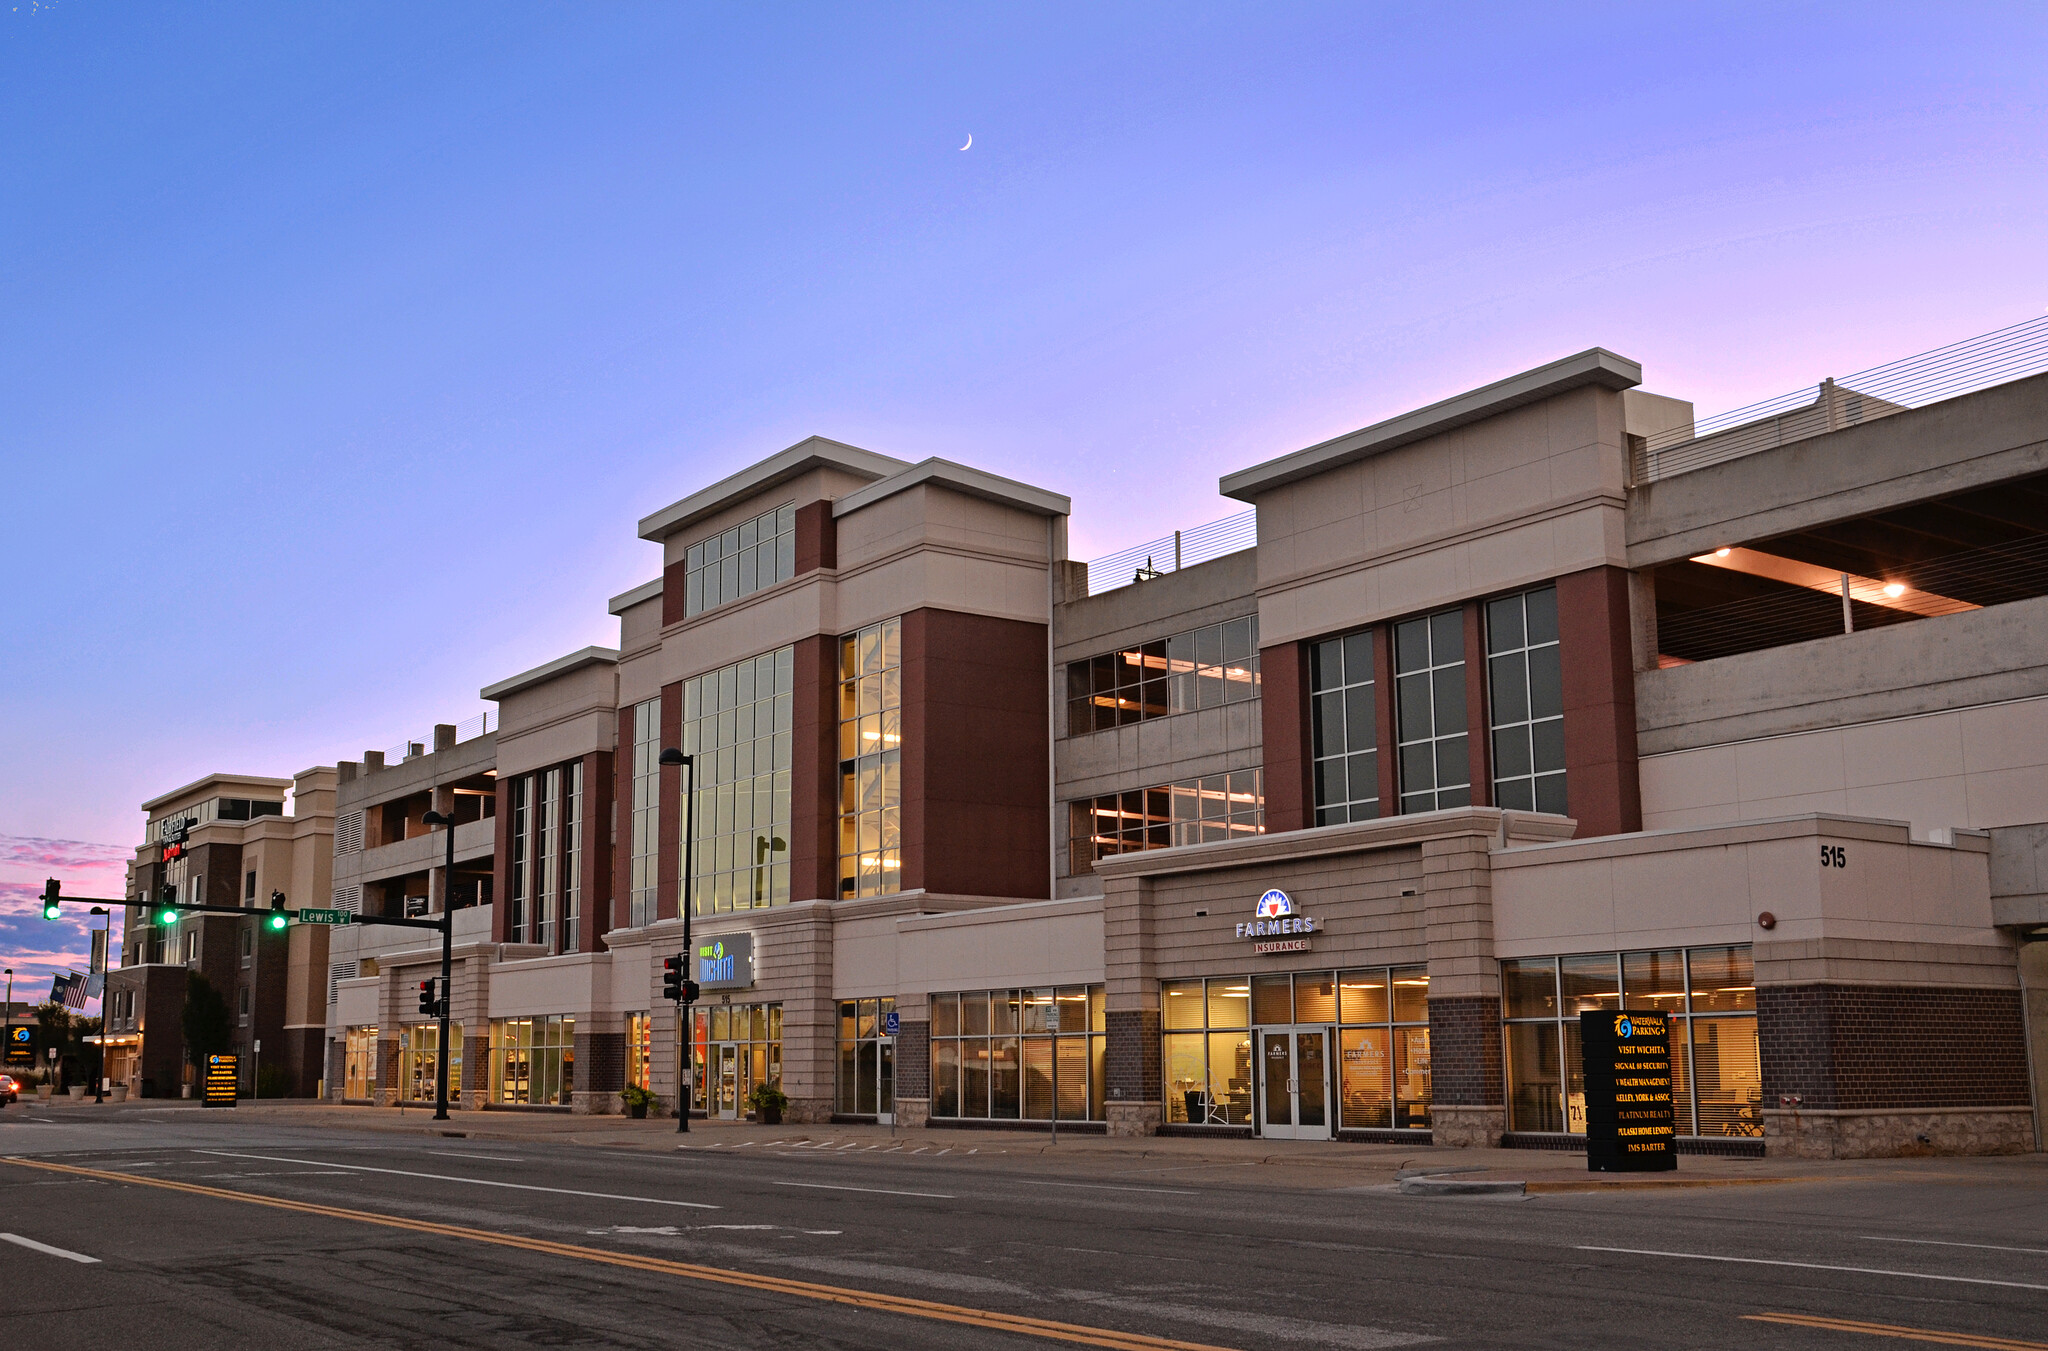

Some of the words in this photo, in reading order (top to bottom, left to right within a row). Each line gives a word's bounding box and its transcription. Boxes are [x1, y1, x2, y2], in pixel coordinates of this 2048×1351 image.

[1821, 846, 1846, 868] 515
[302, 910, 334, 923] Lewis
[1236, 917, 1313, 938] FARMERS
[700, 946, 713, 956] VISIT
[1254, 941, 1306, 952] INSURANCE
[700, 954, 734, 982] WICHITA
[722, 995, 730, 1004] 515
[1618, 1046, 1636, 1054] VISIT
[1616, 1093, 1635, 1102] KELLEY,
[1618, 1128, 1637, 1136] PULASKI
[1638, 1127, 1652, 1135] HOME
[1628, 1144, 1640, 1152] IMS
[1642, 1142, 1666, 1151] BARTER
